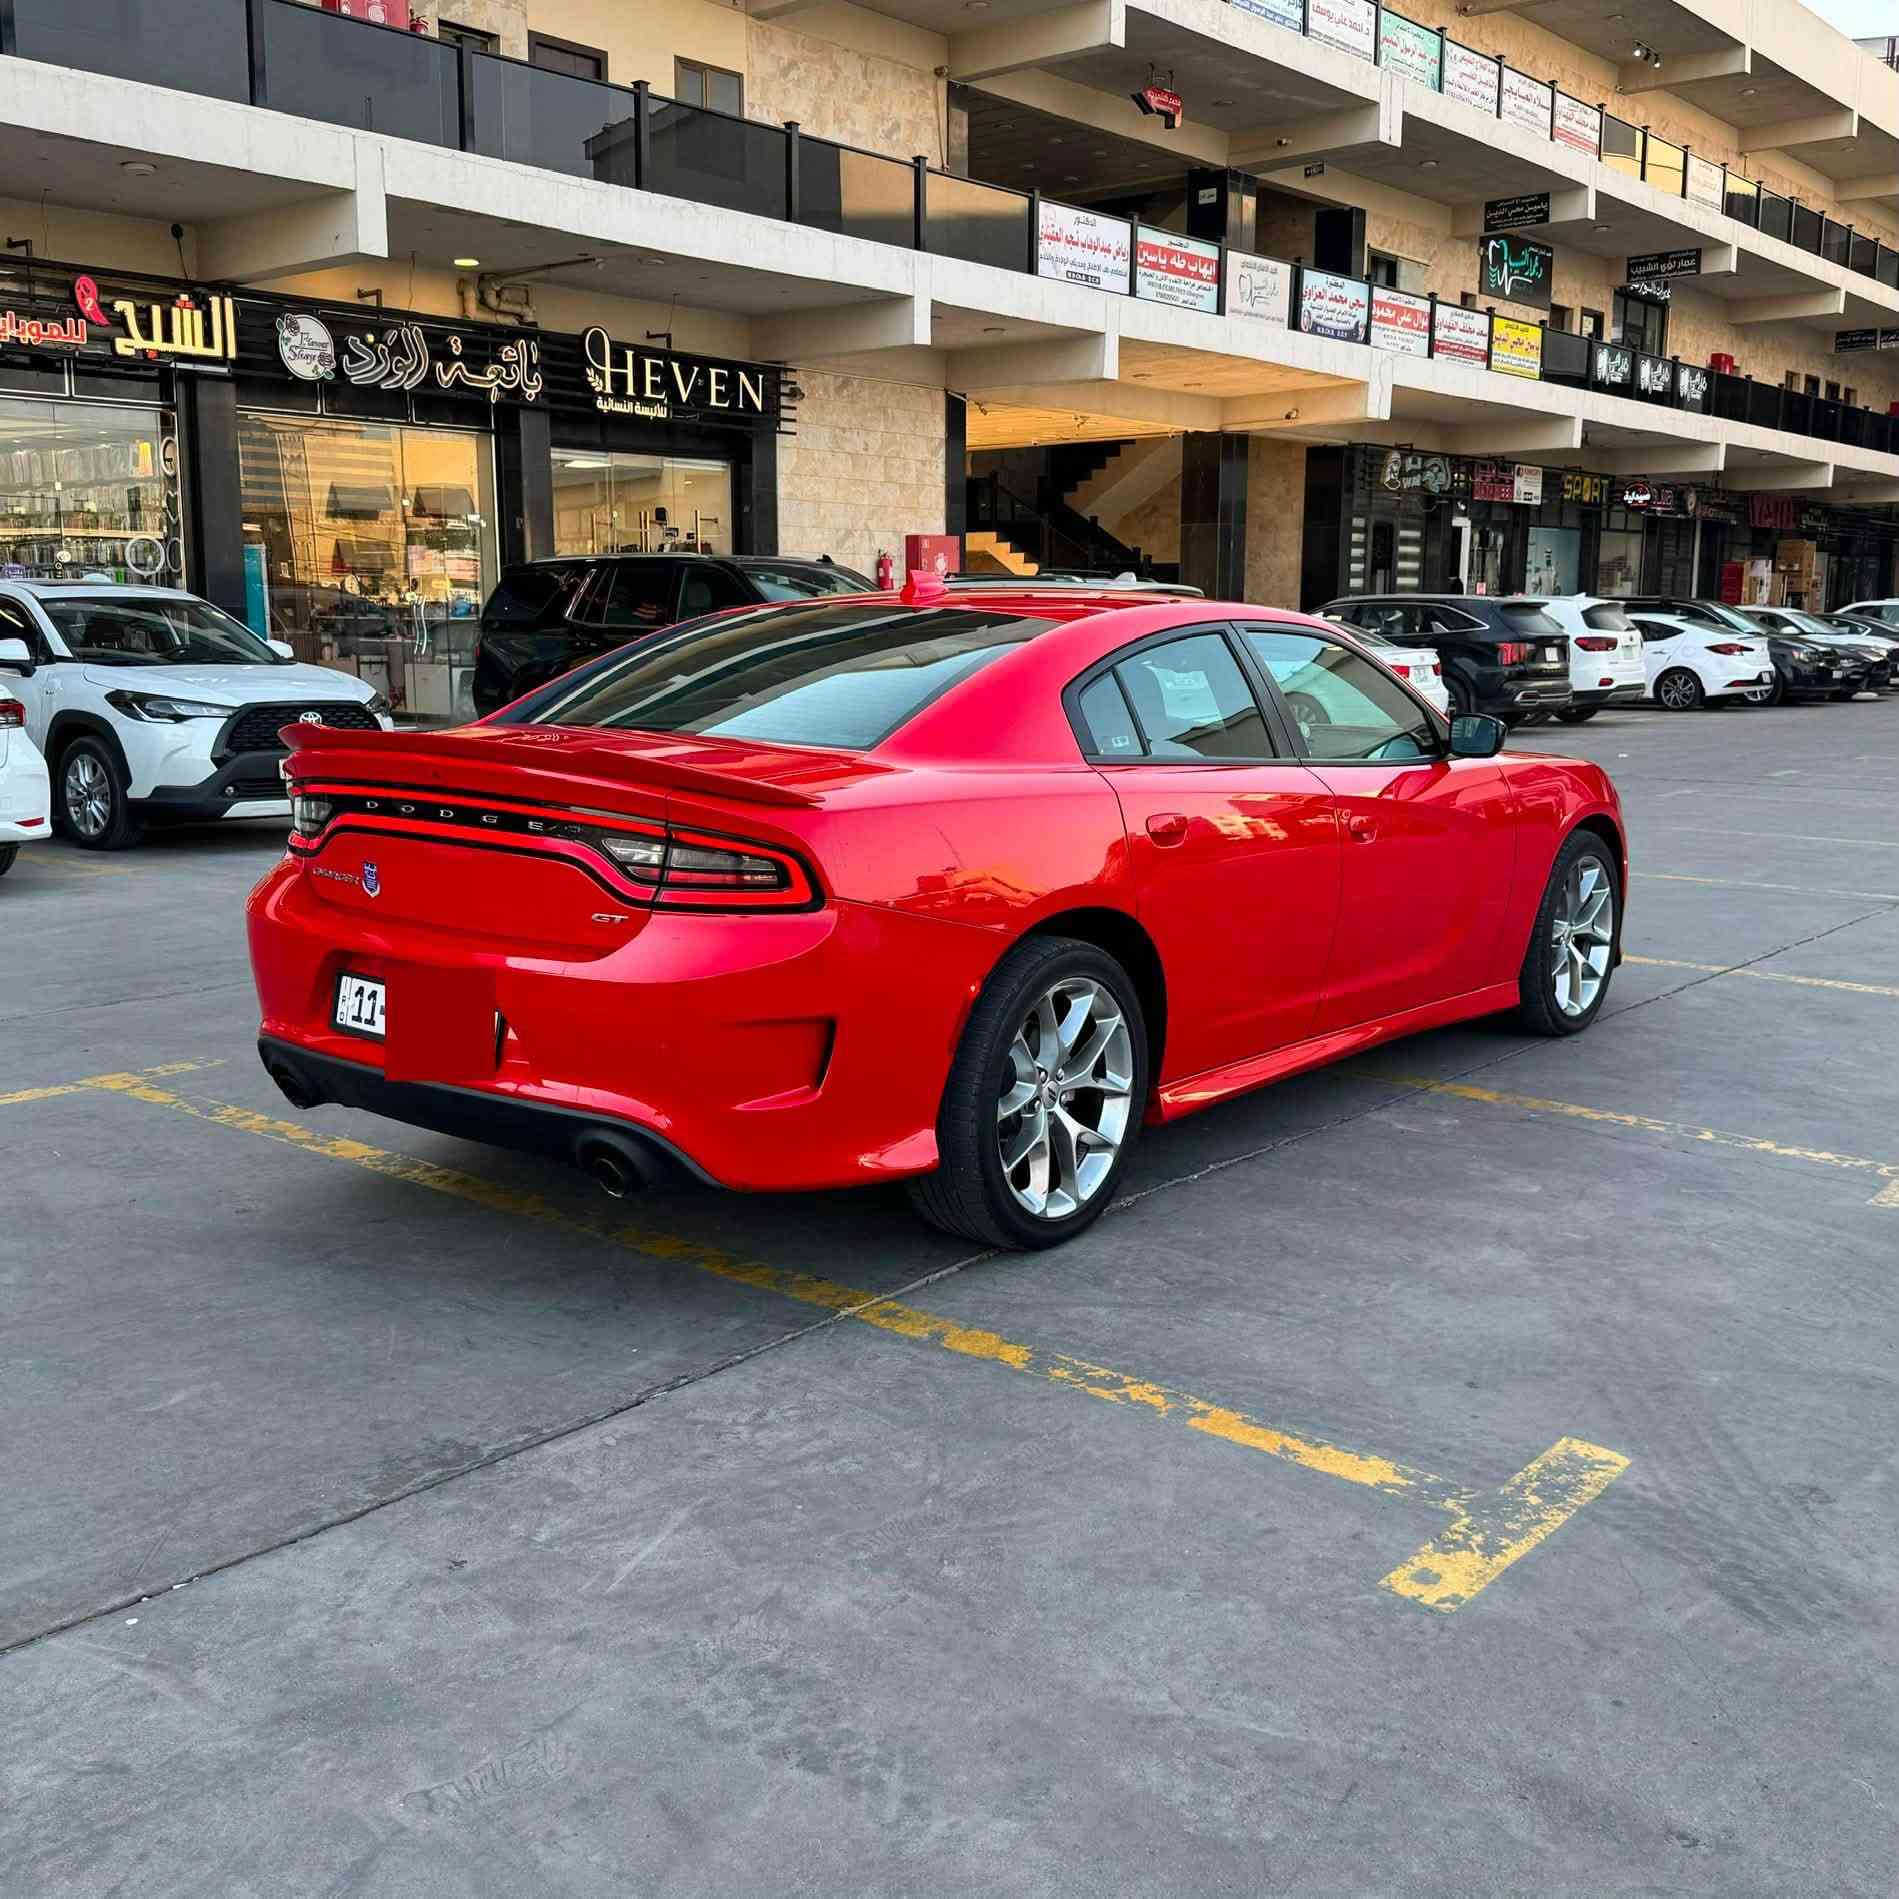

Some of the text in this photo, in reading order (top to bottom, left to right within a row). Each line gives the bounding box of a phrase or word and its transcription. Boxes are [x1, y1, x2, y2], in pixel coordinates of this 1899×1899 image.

[1169, 252, 1187, 270] طه
[1397, 309, 1413, 327] علي
[435, 335, 543, 402] بائعة
[584, 326, 764, 414] HEVEN
[365, 800, 545, 833] DODGE
[590, 912, 629, 924] GT
